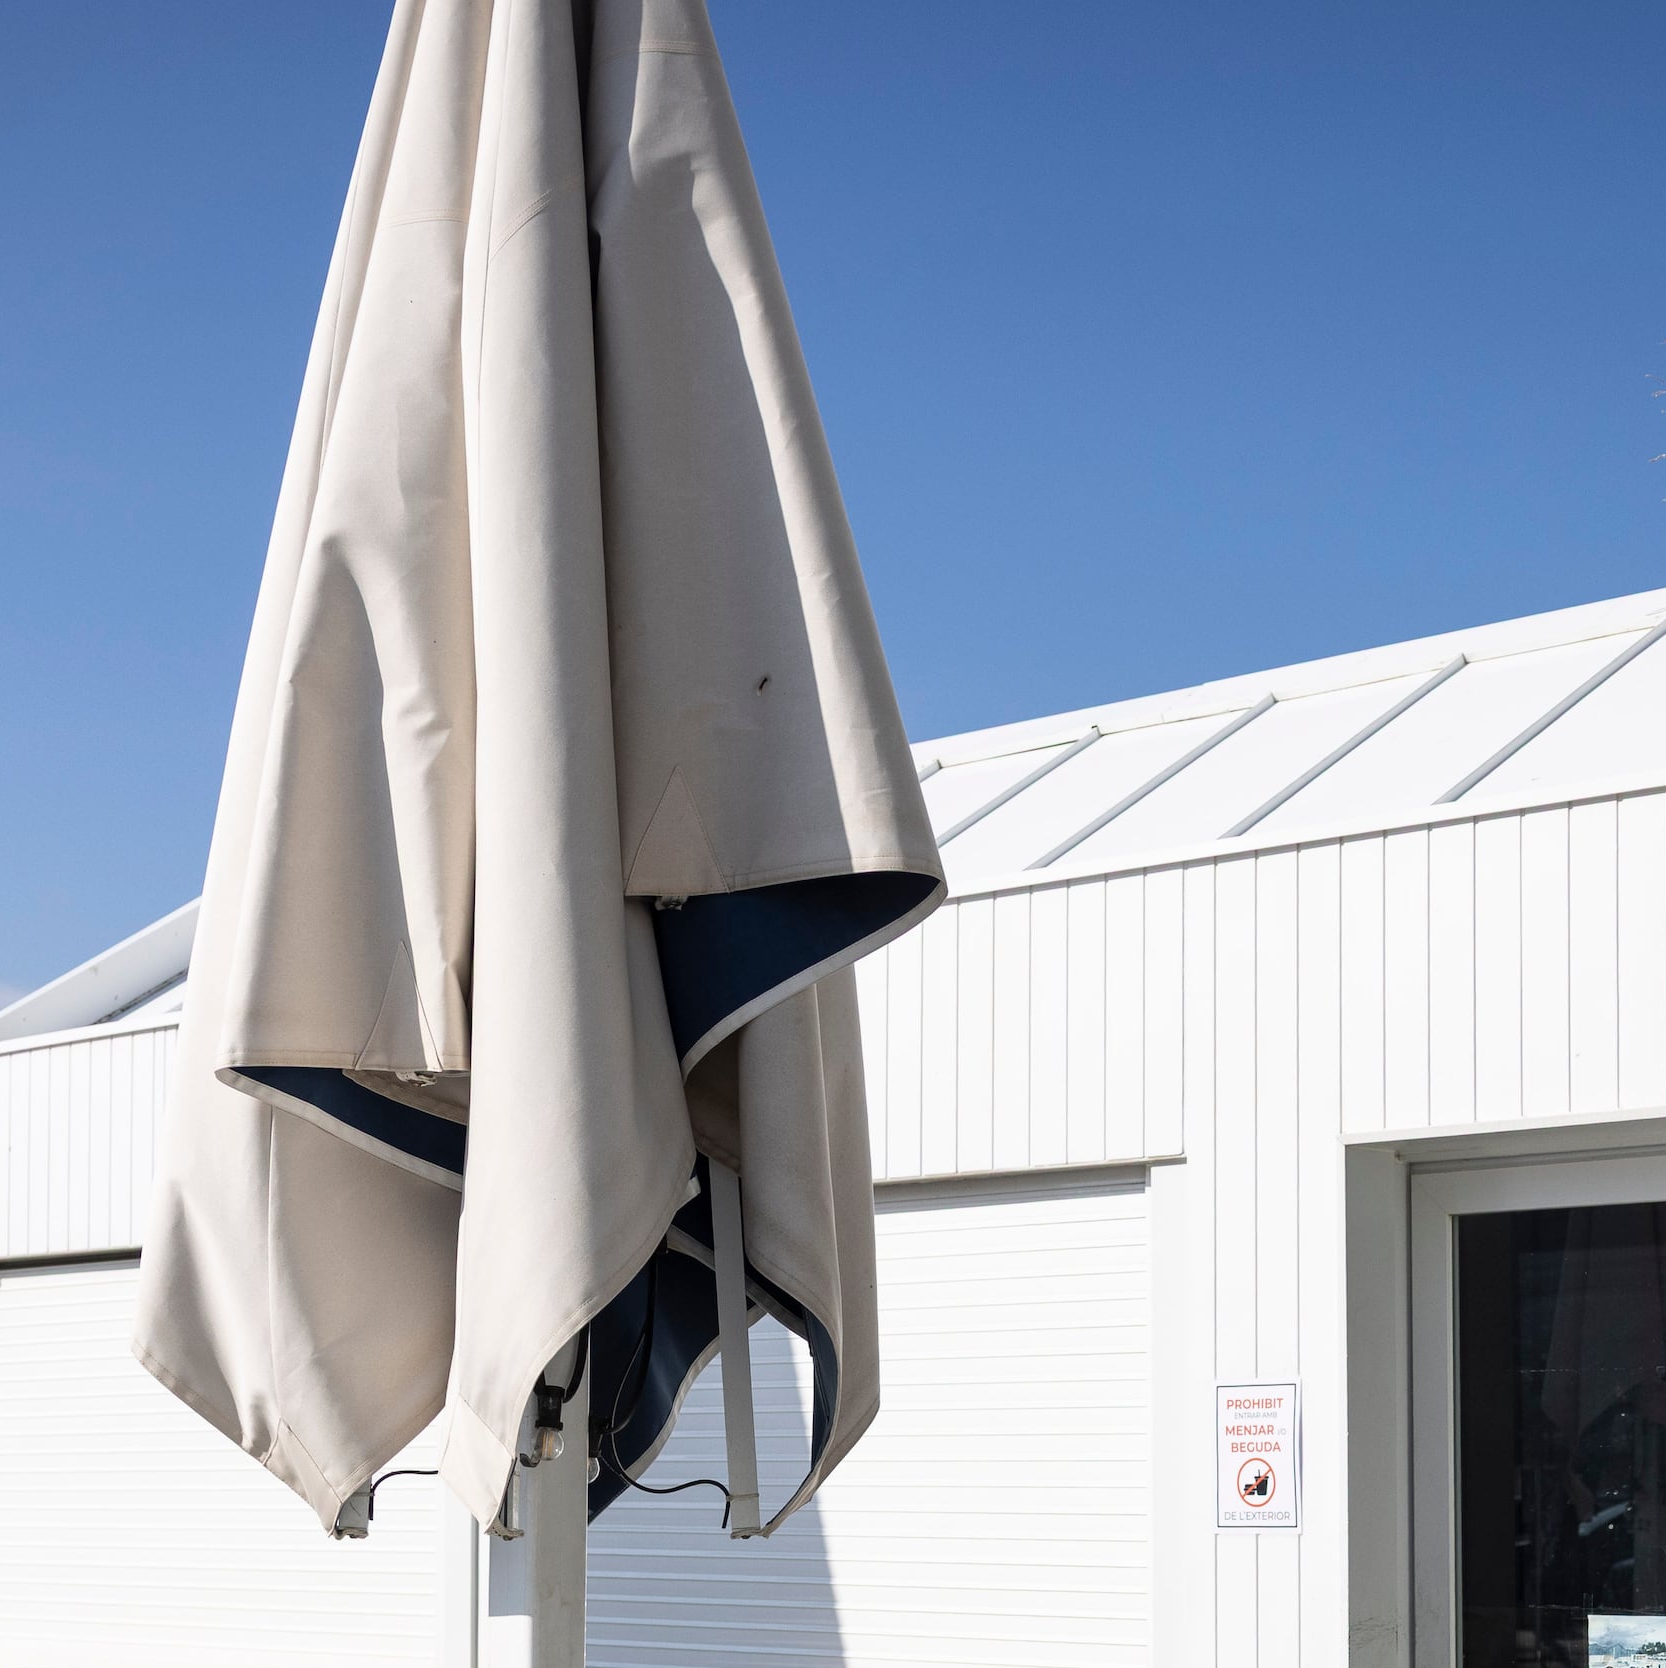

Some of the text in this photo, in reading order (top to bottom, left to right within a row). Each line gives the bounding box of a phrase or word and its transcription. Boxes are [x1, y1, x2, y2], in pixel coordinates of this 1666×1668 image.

[1226, 1398, 1284, 1410] PROHIBIT
[1234, 1412, 1261, 1420] ENTRAR
[1225, 1424, 1275, 1436] MENJAR
[1231, 1441, 1281, 1453] BEGUDA
[1224, 1511, 1237, 1521] DE
